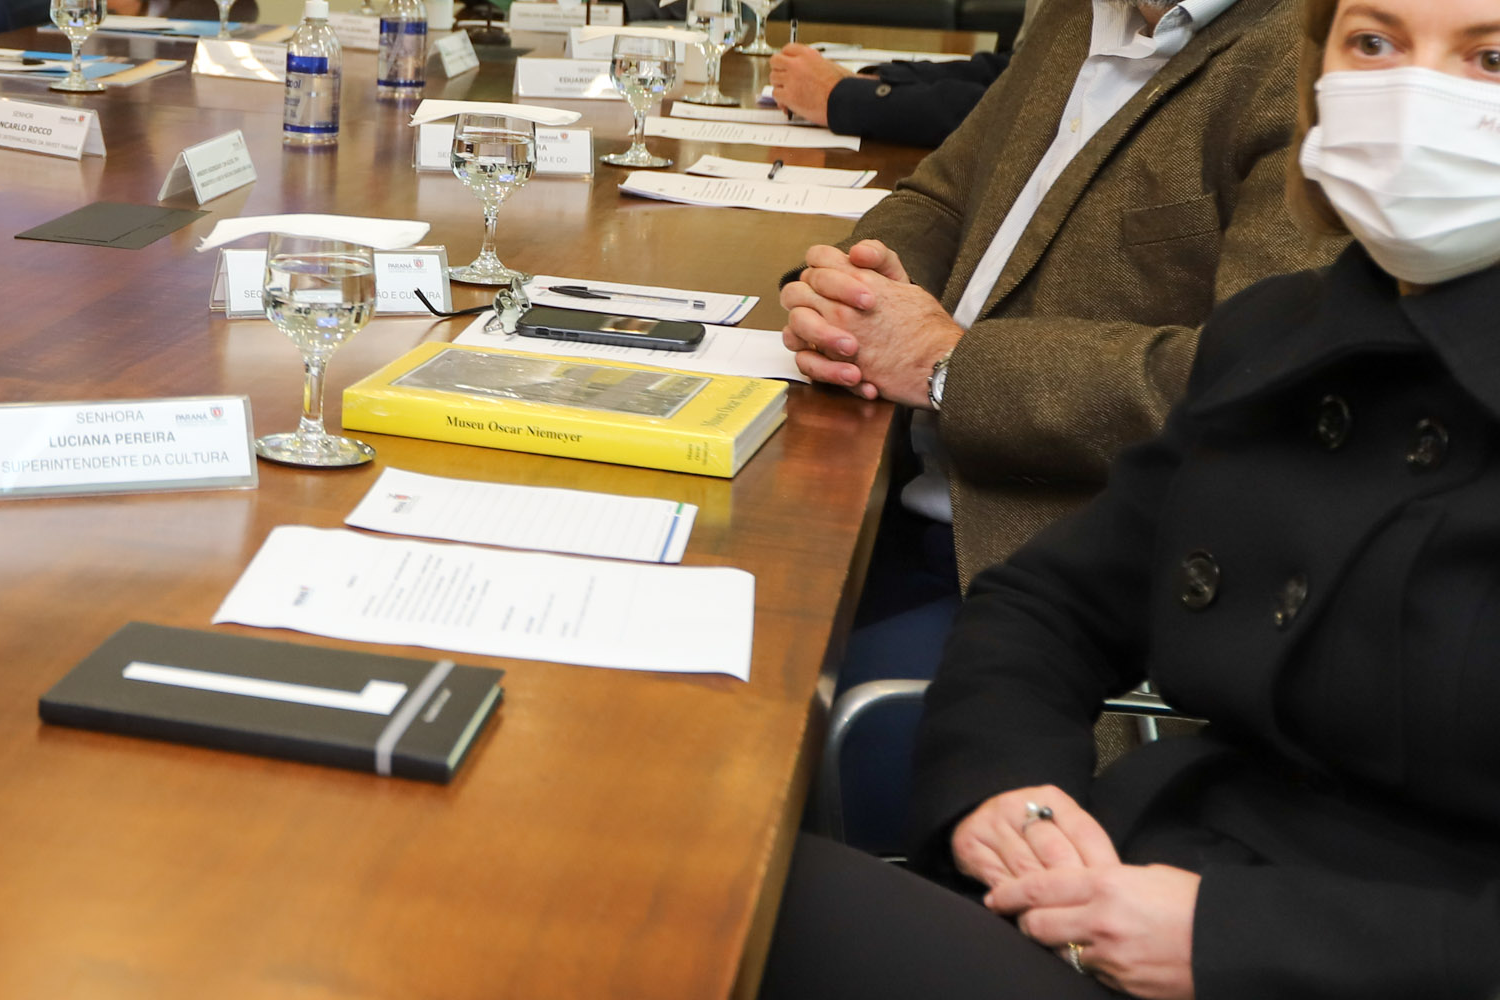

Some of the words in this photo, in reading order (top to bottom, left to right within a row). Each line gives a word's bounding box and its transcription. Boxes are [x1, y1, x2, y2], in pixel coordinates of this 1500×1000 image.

[27, 124, 53, 136] ROCCO
[536, 144, 548, 152] RA
[243, 289, 263, 299] SEC
[399, 290, 441, 300] CULURA
[75, 409, 145, 424] SENHORA
[446, 415, 485, 430] Museu
[488, 421, 523, 435] Oscar
[526, 425, 583, 443] Niemeyer
[48, 433, 111, 449] LUCIANA
[115, 431, 176, 445] PEREIRA
[1, 454, 139, 474] SUPERINTENDENTE
[142, 453, 161, 467] DA
[164, 450, 230, 466] CULTURA
